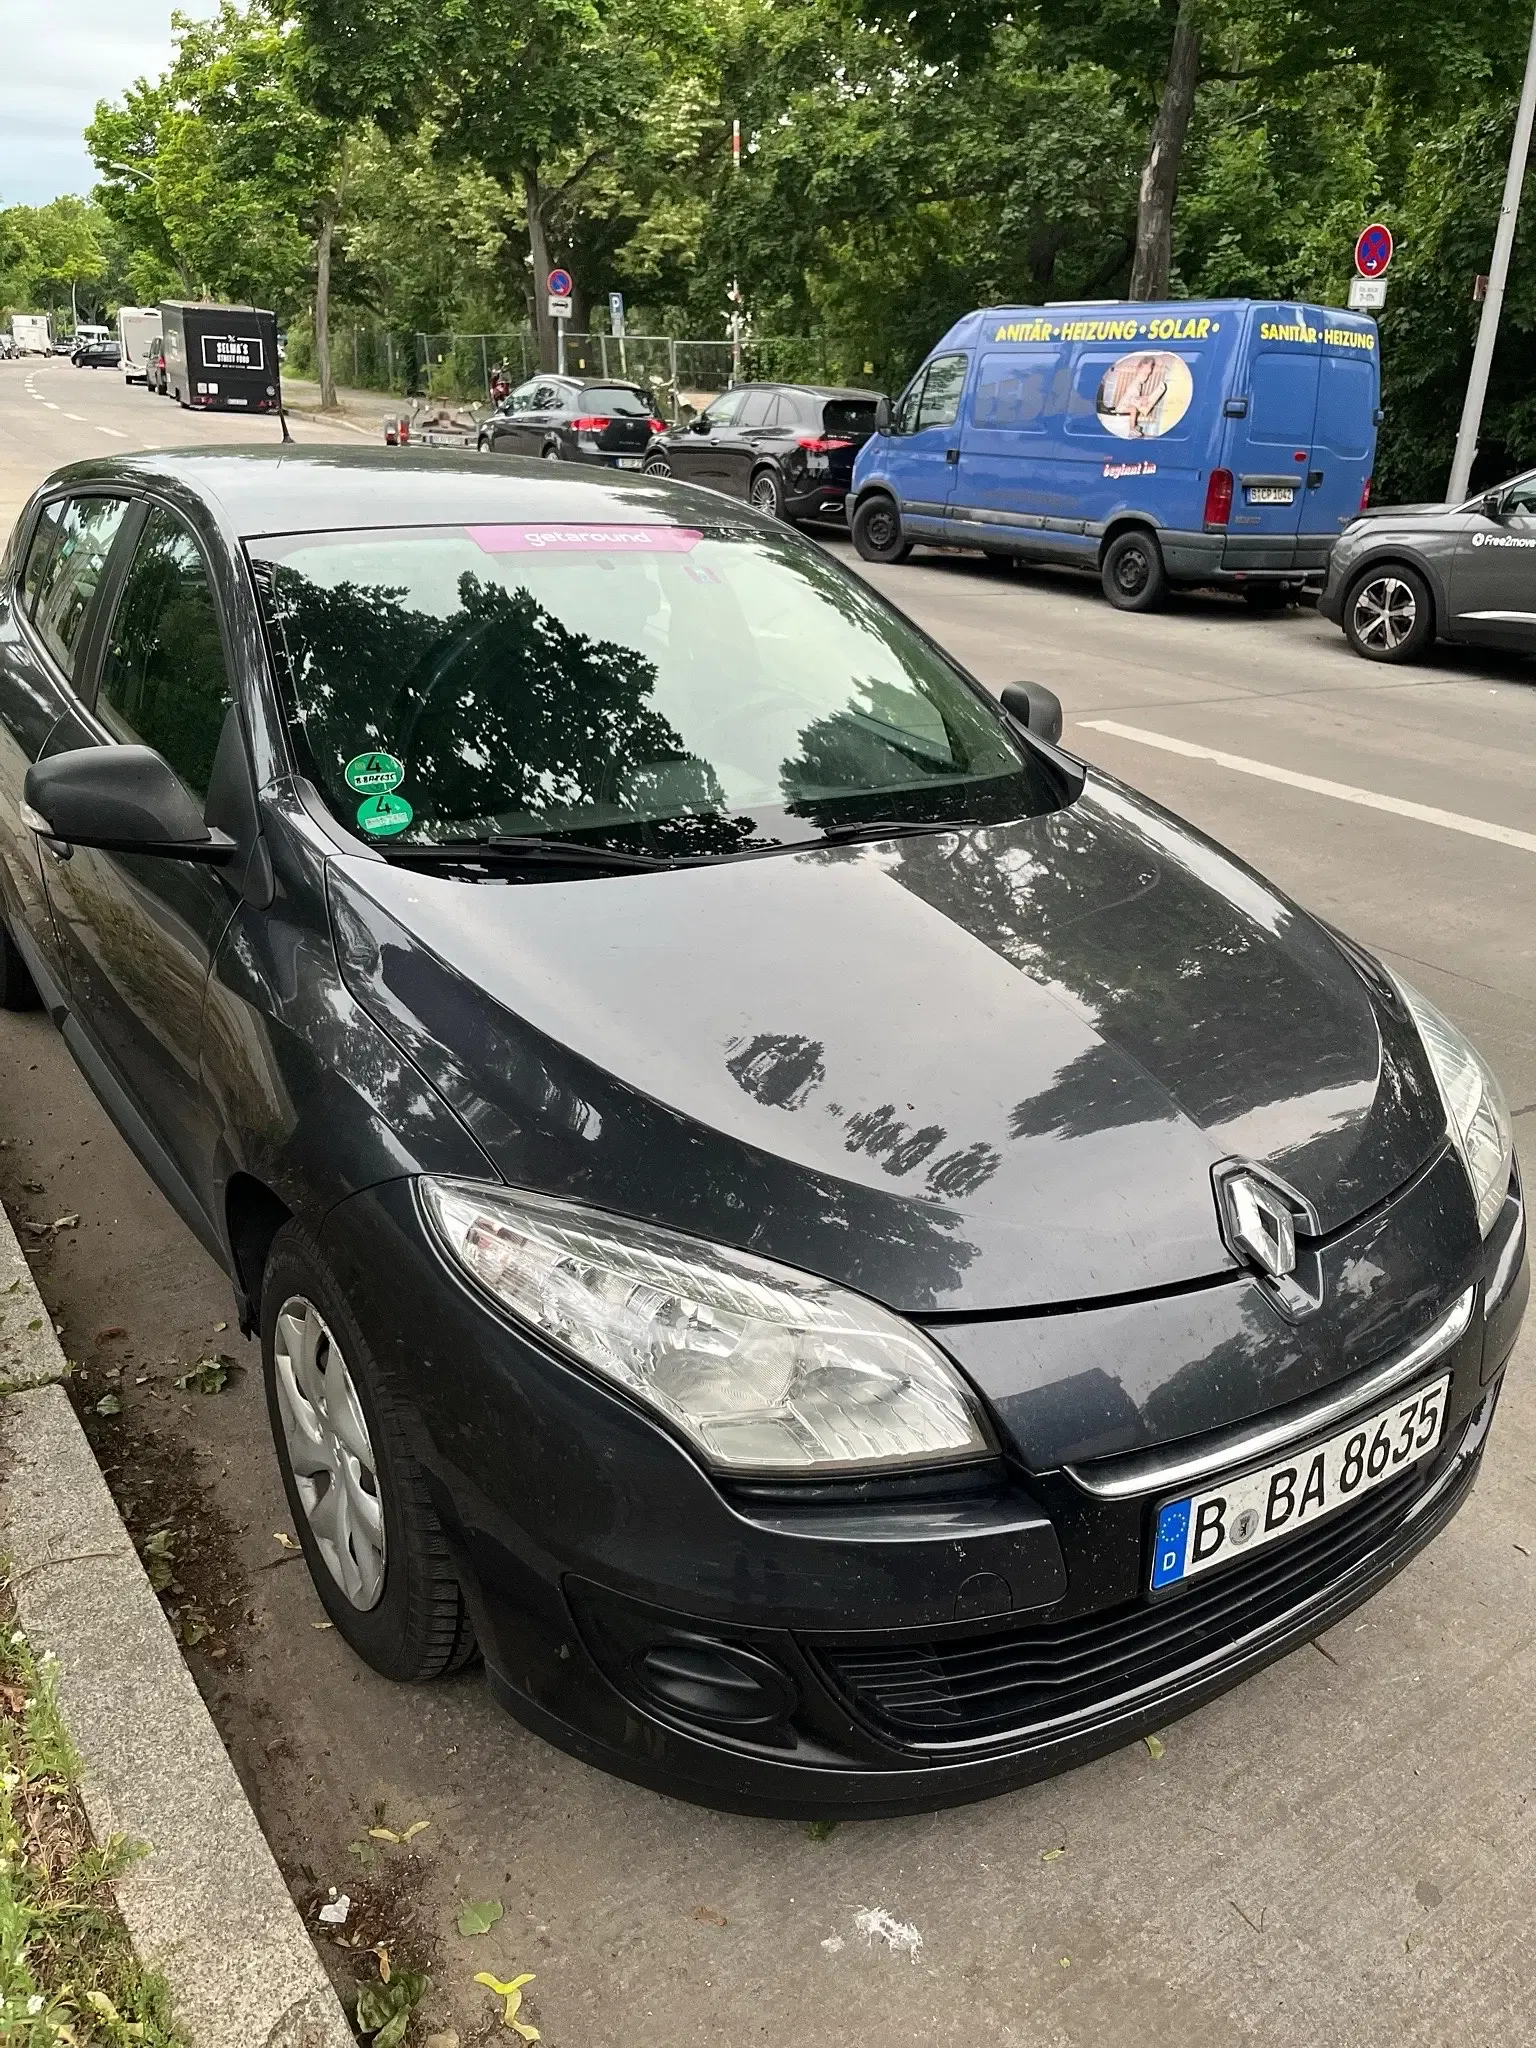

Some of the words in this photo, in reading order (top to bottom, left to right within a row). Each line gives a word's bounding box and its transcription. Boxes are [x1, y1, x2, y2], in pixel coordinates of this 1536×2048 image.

[612, 296, 620, 313] P
[1061, 320, 1137, 340] HEIZUNG
[1148, 318, 1210, 339] SOLAR
[1324, 329, 1375, 350] HEIZUNG
[524, 530, 653, 547] getaround
[1484, 534, 1536, 548] Free2move
[366, 755, 382, 773] 4
[375, 796, 392, 813] 4
[1191, 1496, 1227, 1564] B
[1264, 1452, 1326, 1533] BA
[1339, 1387, 1443, 1494] 8635
[1162, 1551, 1176, 1571] D
